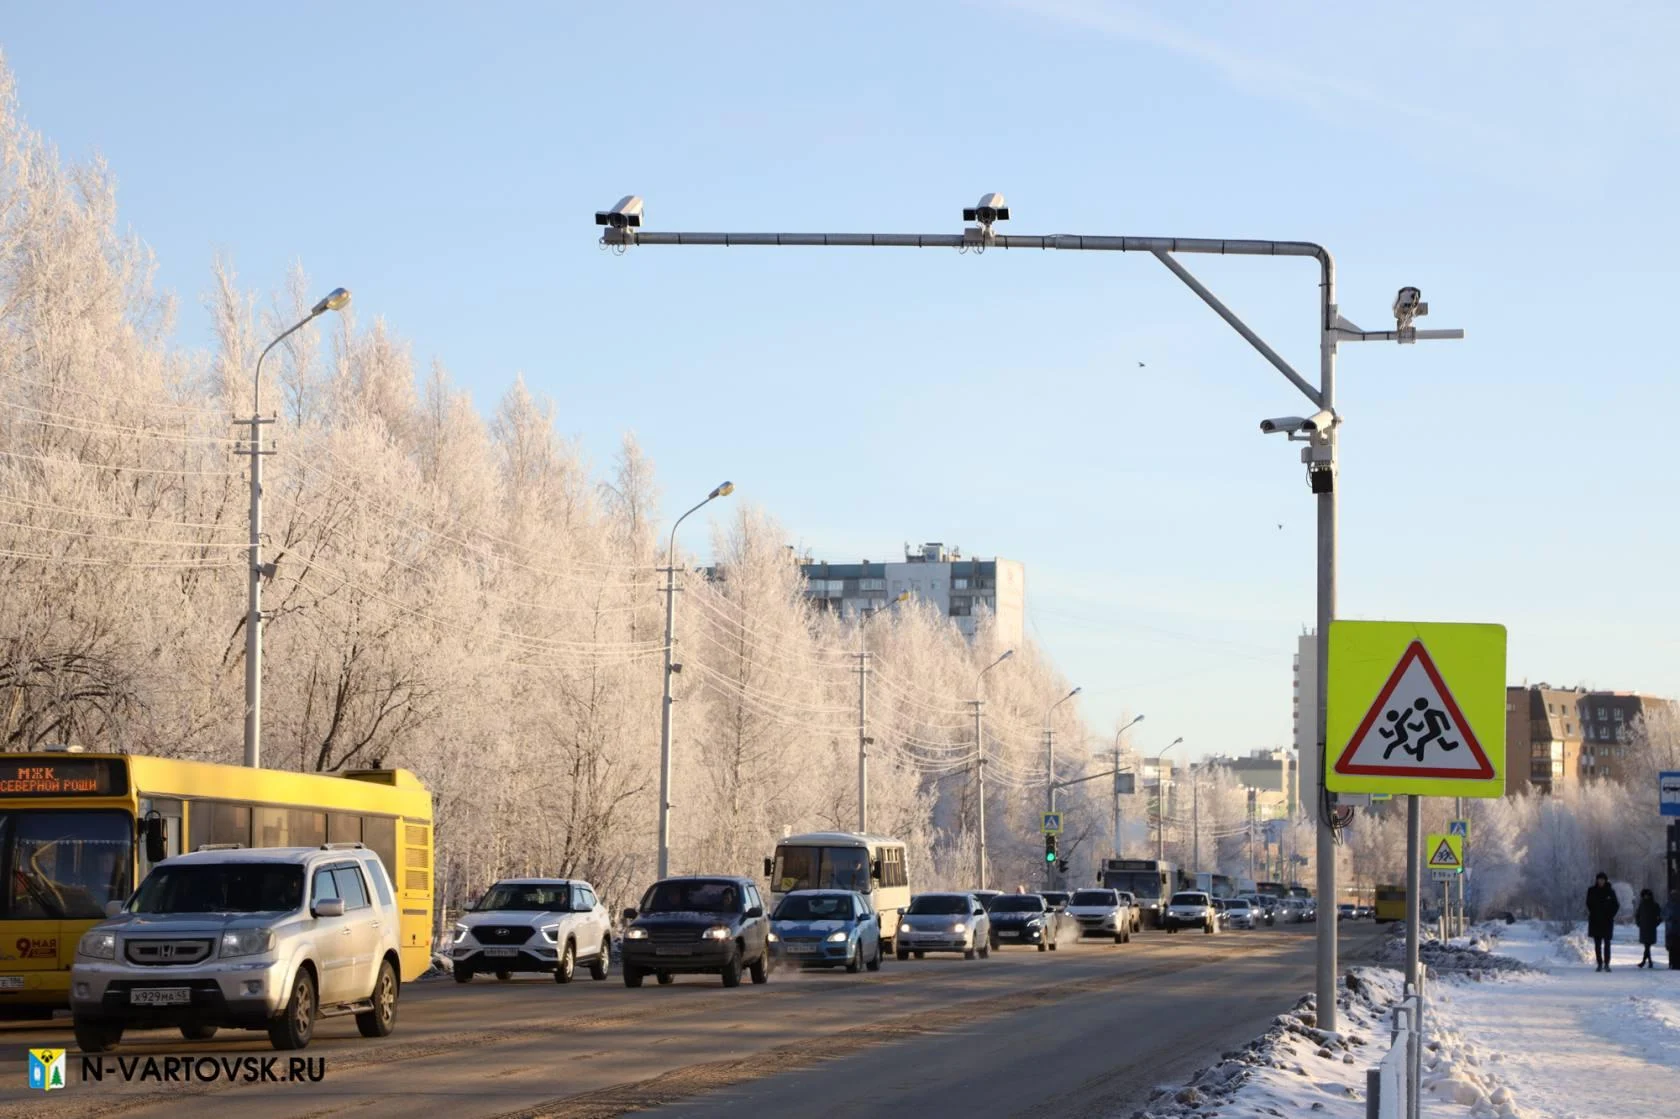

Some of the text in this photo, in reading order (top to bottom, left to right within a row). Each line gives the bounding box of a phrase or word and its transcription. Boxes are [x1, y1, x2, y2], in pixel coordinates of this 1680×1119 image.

[17, 768, 54, 779] МЖК
[0, 779, 97, 792] СЕВЕРНОЙ РОЩИ
[15, 937, 31, 958] 9
[32, 939, 57, 948] МАЯ
